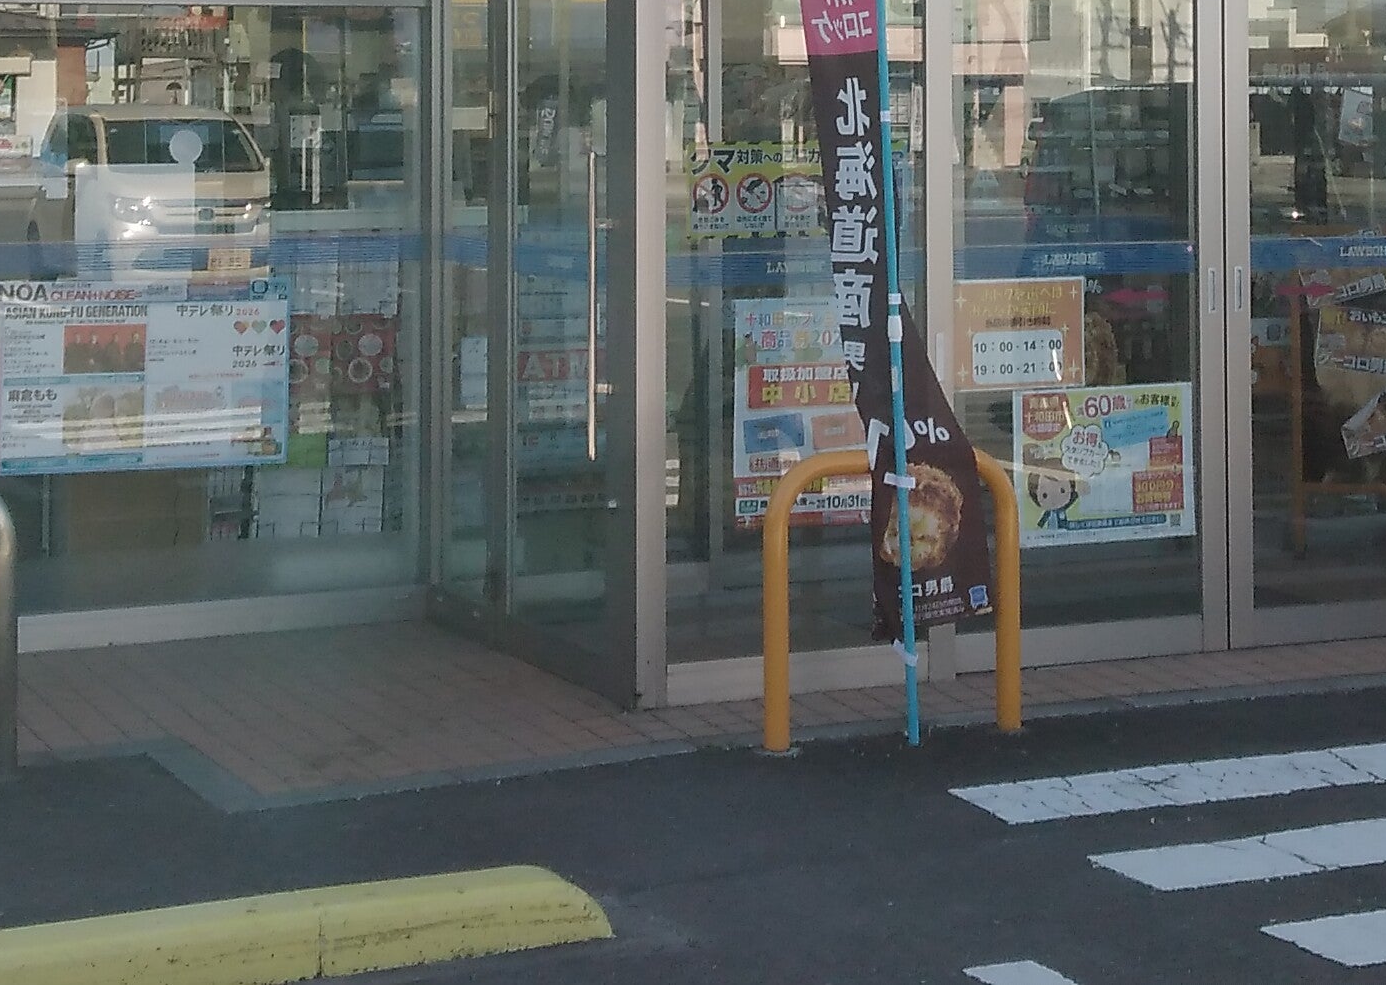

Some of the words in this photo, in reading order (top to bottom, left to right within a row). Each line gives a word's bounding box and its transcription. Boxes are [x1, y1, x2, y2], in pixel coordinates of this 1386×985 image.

[0, 284, 48, 301] NOA
[85, 304, 148, 318] GENERATION
[177, 304, 233, 317] 中テレ祭り
[232, 344, 285, 358] 中テレ祭り
